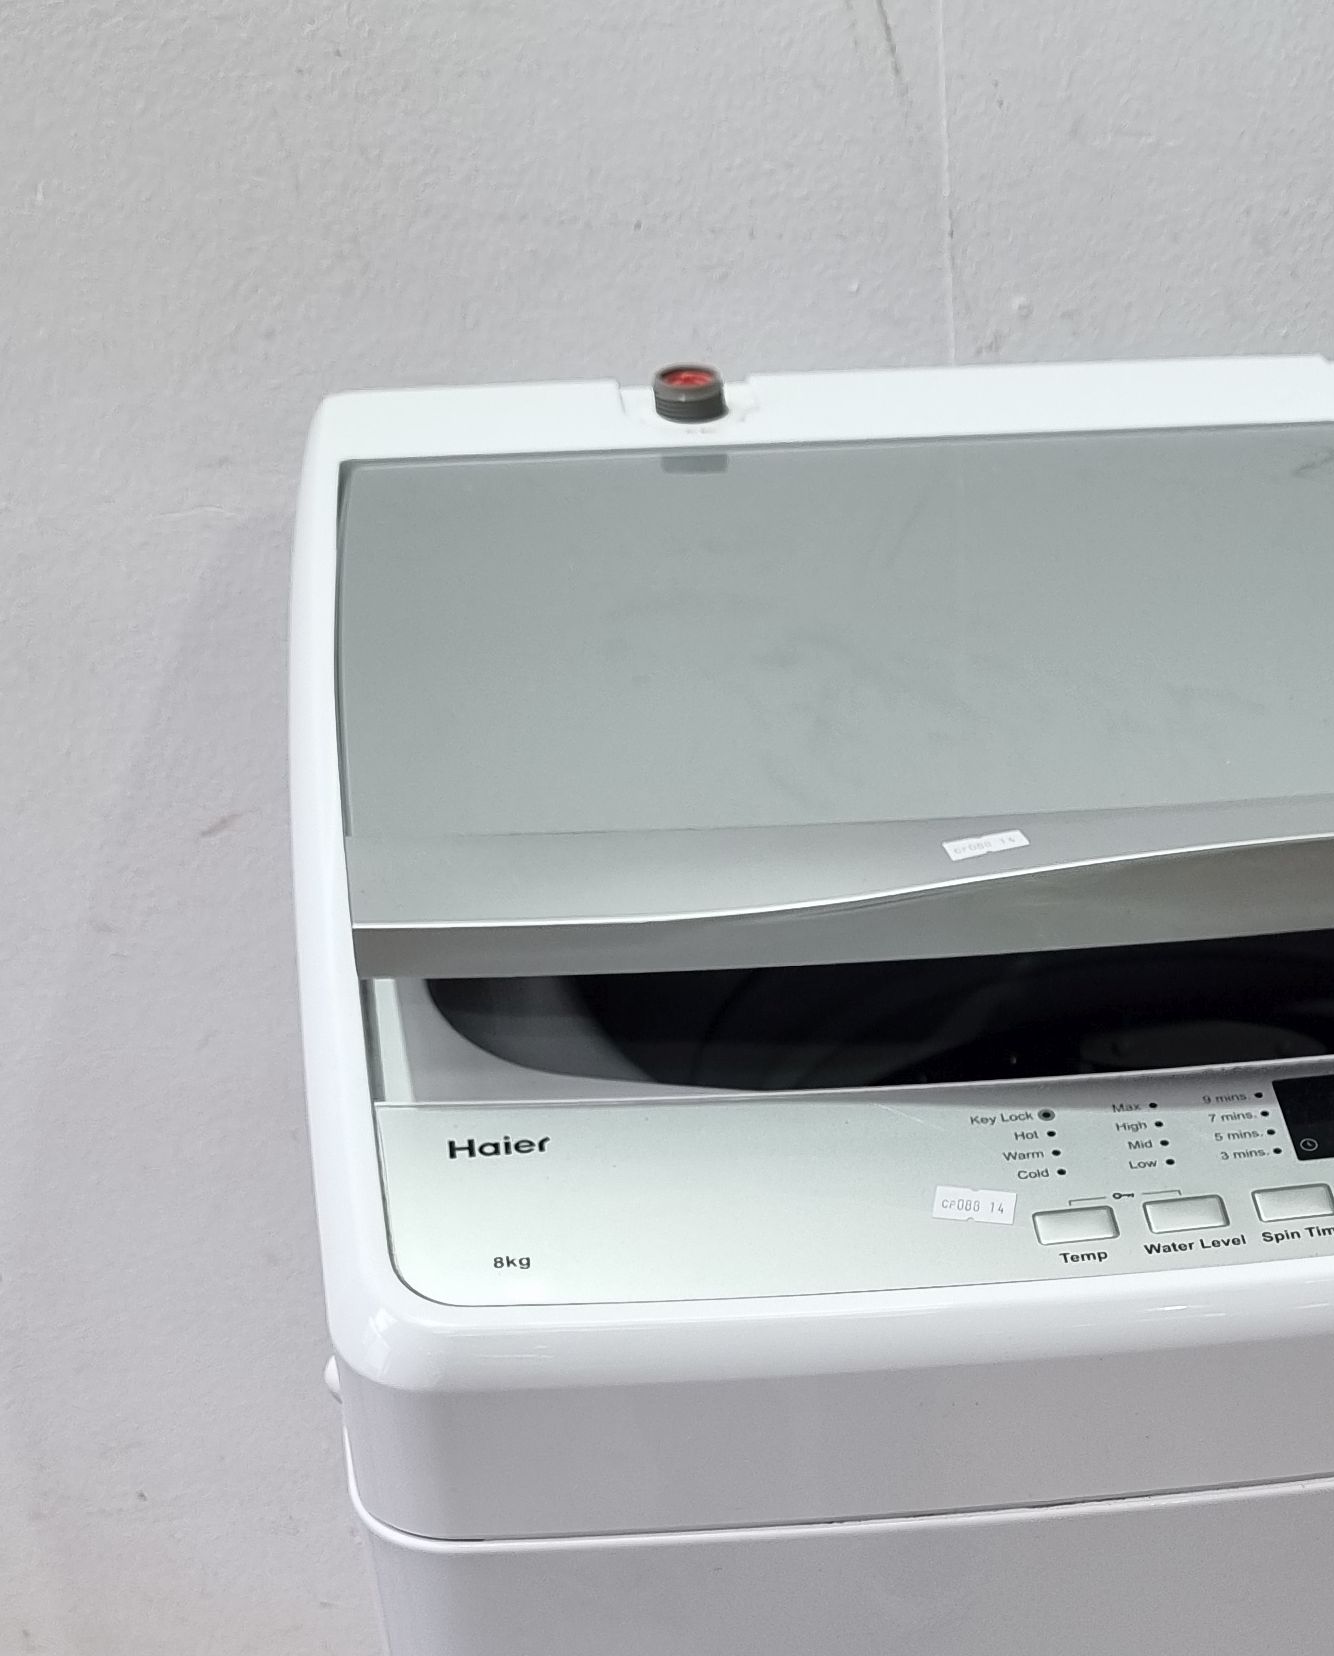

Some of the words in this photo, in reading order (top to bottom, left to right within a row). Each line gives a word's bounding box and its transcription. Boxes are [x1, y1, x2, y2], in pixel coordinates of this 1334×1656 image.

[1112, 1101, 1141, 1114] Max
[970, 1114, 997, 1127] Key
[1000, 1109, 1034, 1123] Lock
[1208, 1112, 1217, 1123] 7
[1220, 1109, 1257, 1122] mins.
[1115, 1119, 1148, 1133] High
[1014, 1130, 1039, 1141] Hot
[1214, 1131, 1223, 1142] 5
[1226, 1127, 1264, 1141] mins.
[448, 1134, 551, 1159] Haier
[1128, 1138, 1153, 1150] Mid
[1002, 1149, 1045, 1162] Warm
[1220, 1150, 1229, 1161] 3
[1232, 1146, 1270, 1160] mins.
[1128, 1158, 1158, 1170] Low
[1017, 1167, 1050, 1180] Cold
[990, 1201, 1004, 1215] 14
[1262, 1228, 1301, 1245] Spin
[1144, 1238, 1195, 1256] Water
[1199, 1233, 1247, 1250] Level
[494, 1255, 530, 1270] 8kg
[1060, 1249, 1108, 1266] Temp
